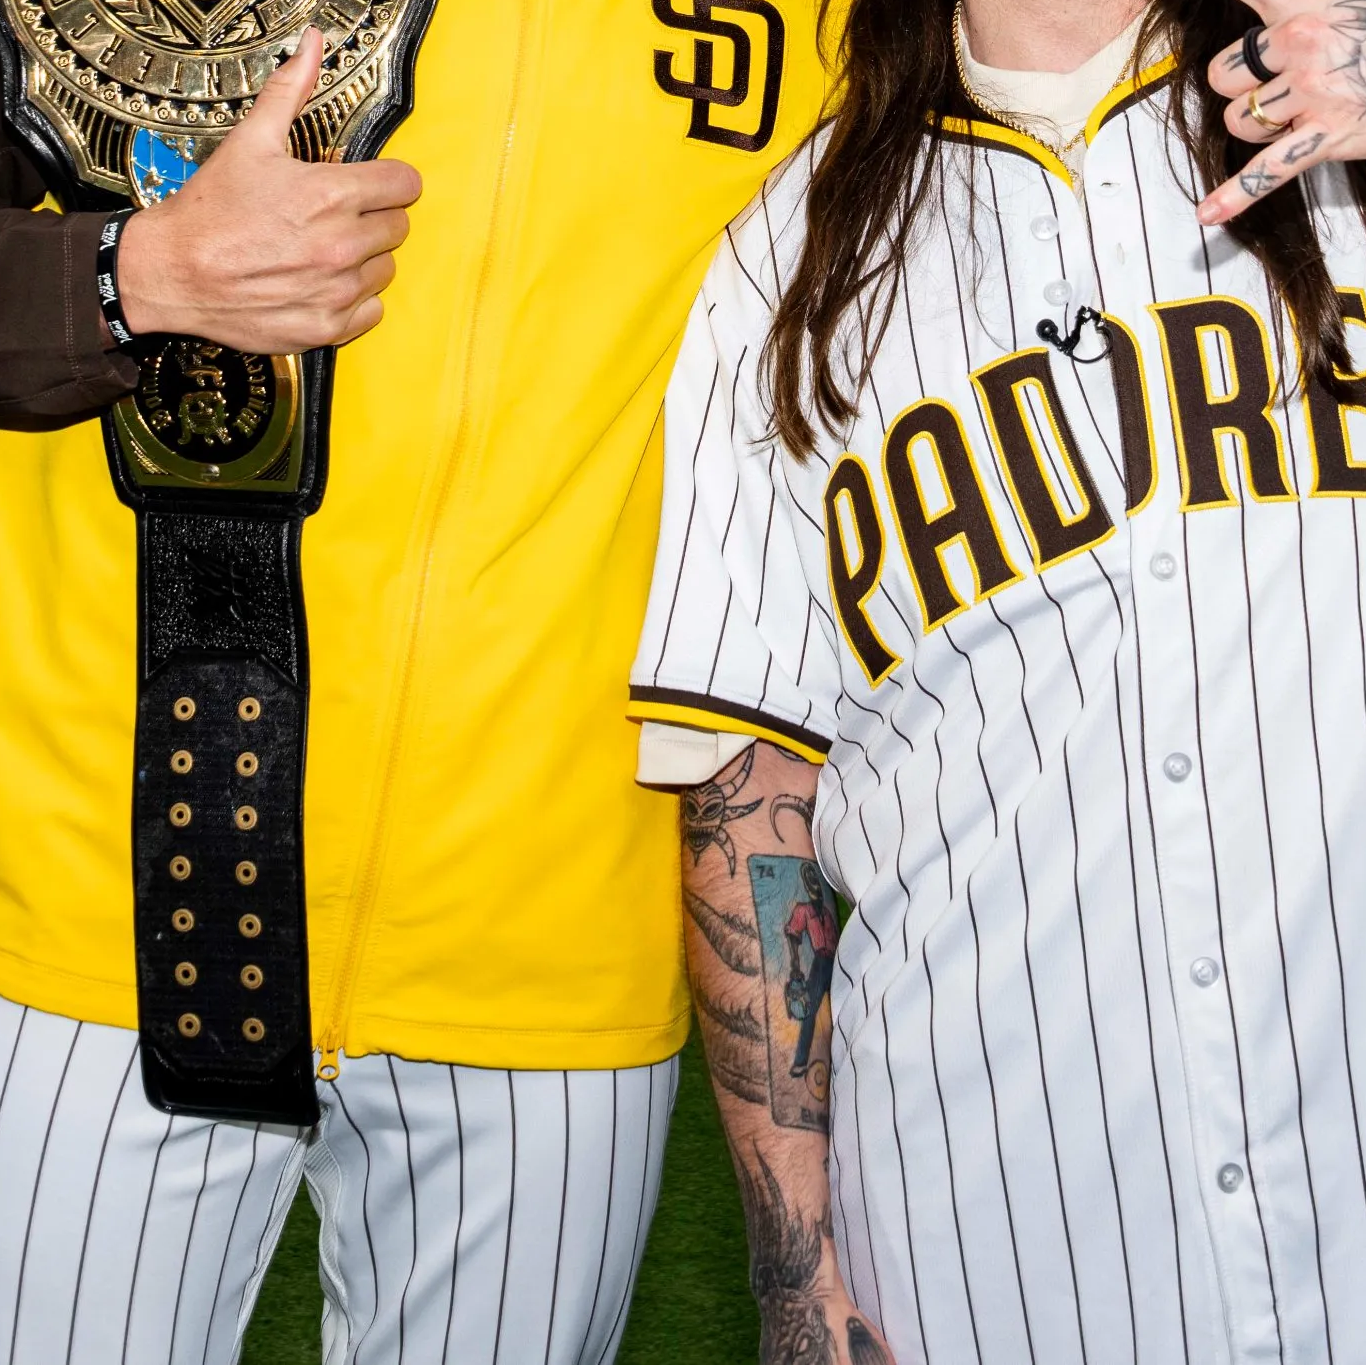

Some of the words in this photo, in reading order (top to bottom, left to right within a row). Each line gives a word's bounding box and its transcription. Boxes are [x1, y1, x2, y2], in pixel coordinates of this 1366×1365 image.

[99, 221, 119, 251] Vibes
[101, 272, 118, 306] Vibes
[111, 319, 133, 344] Vibes
[755, 864, 775, 879] 74
